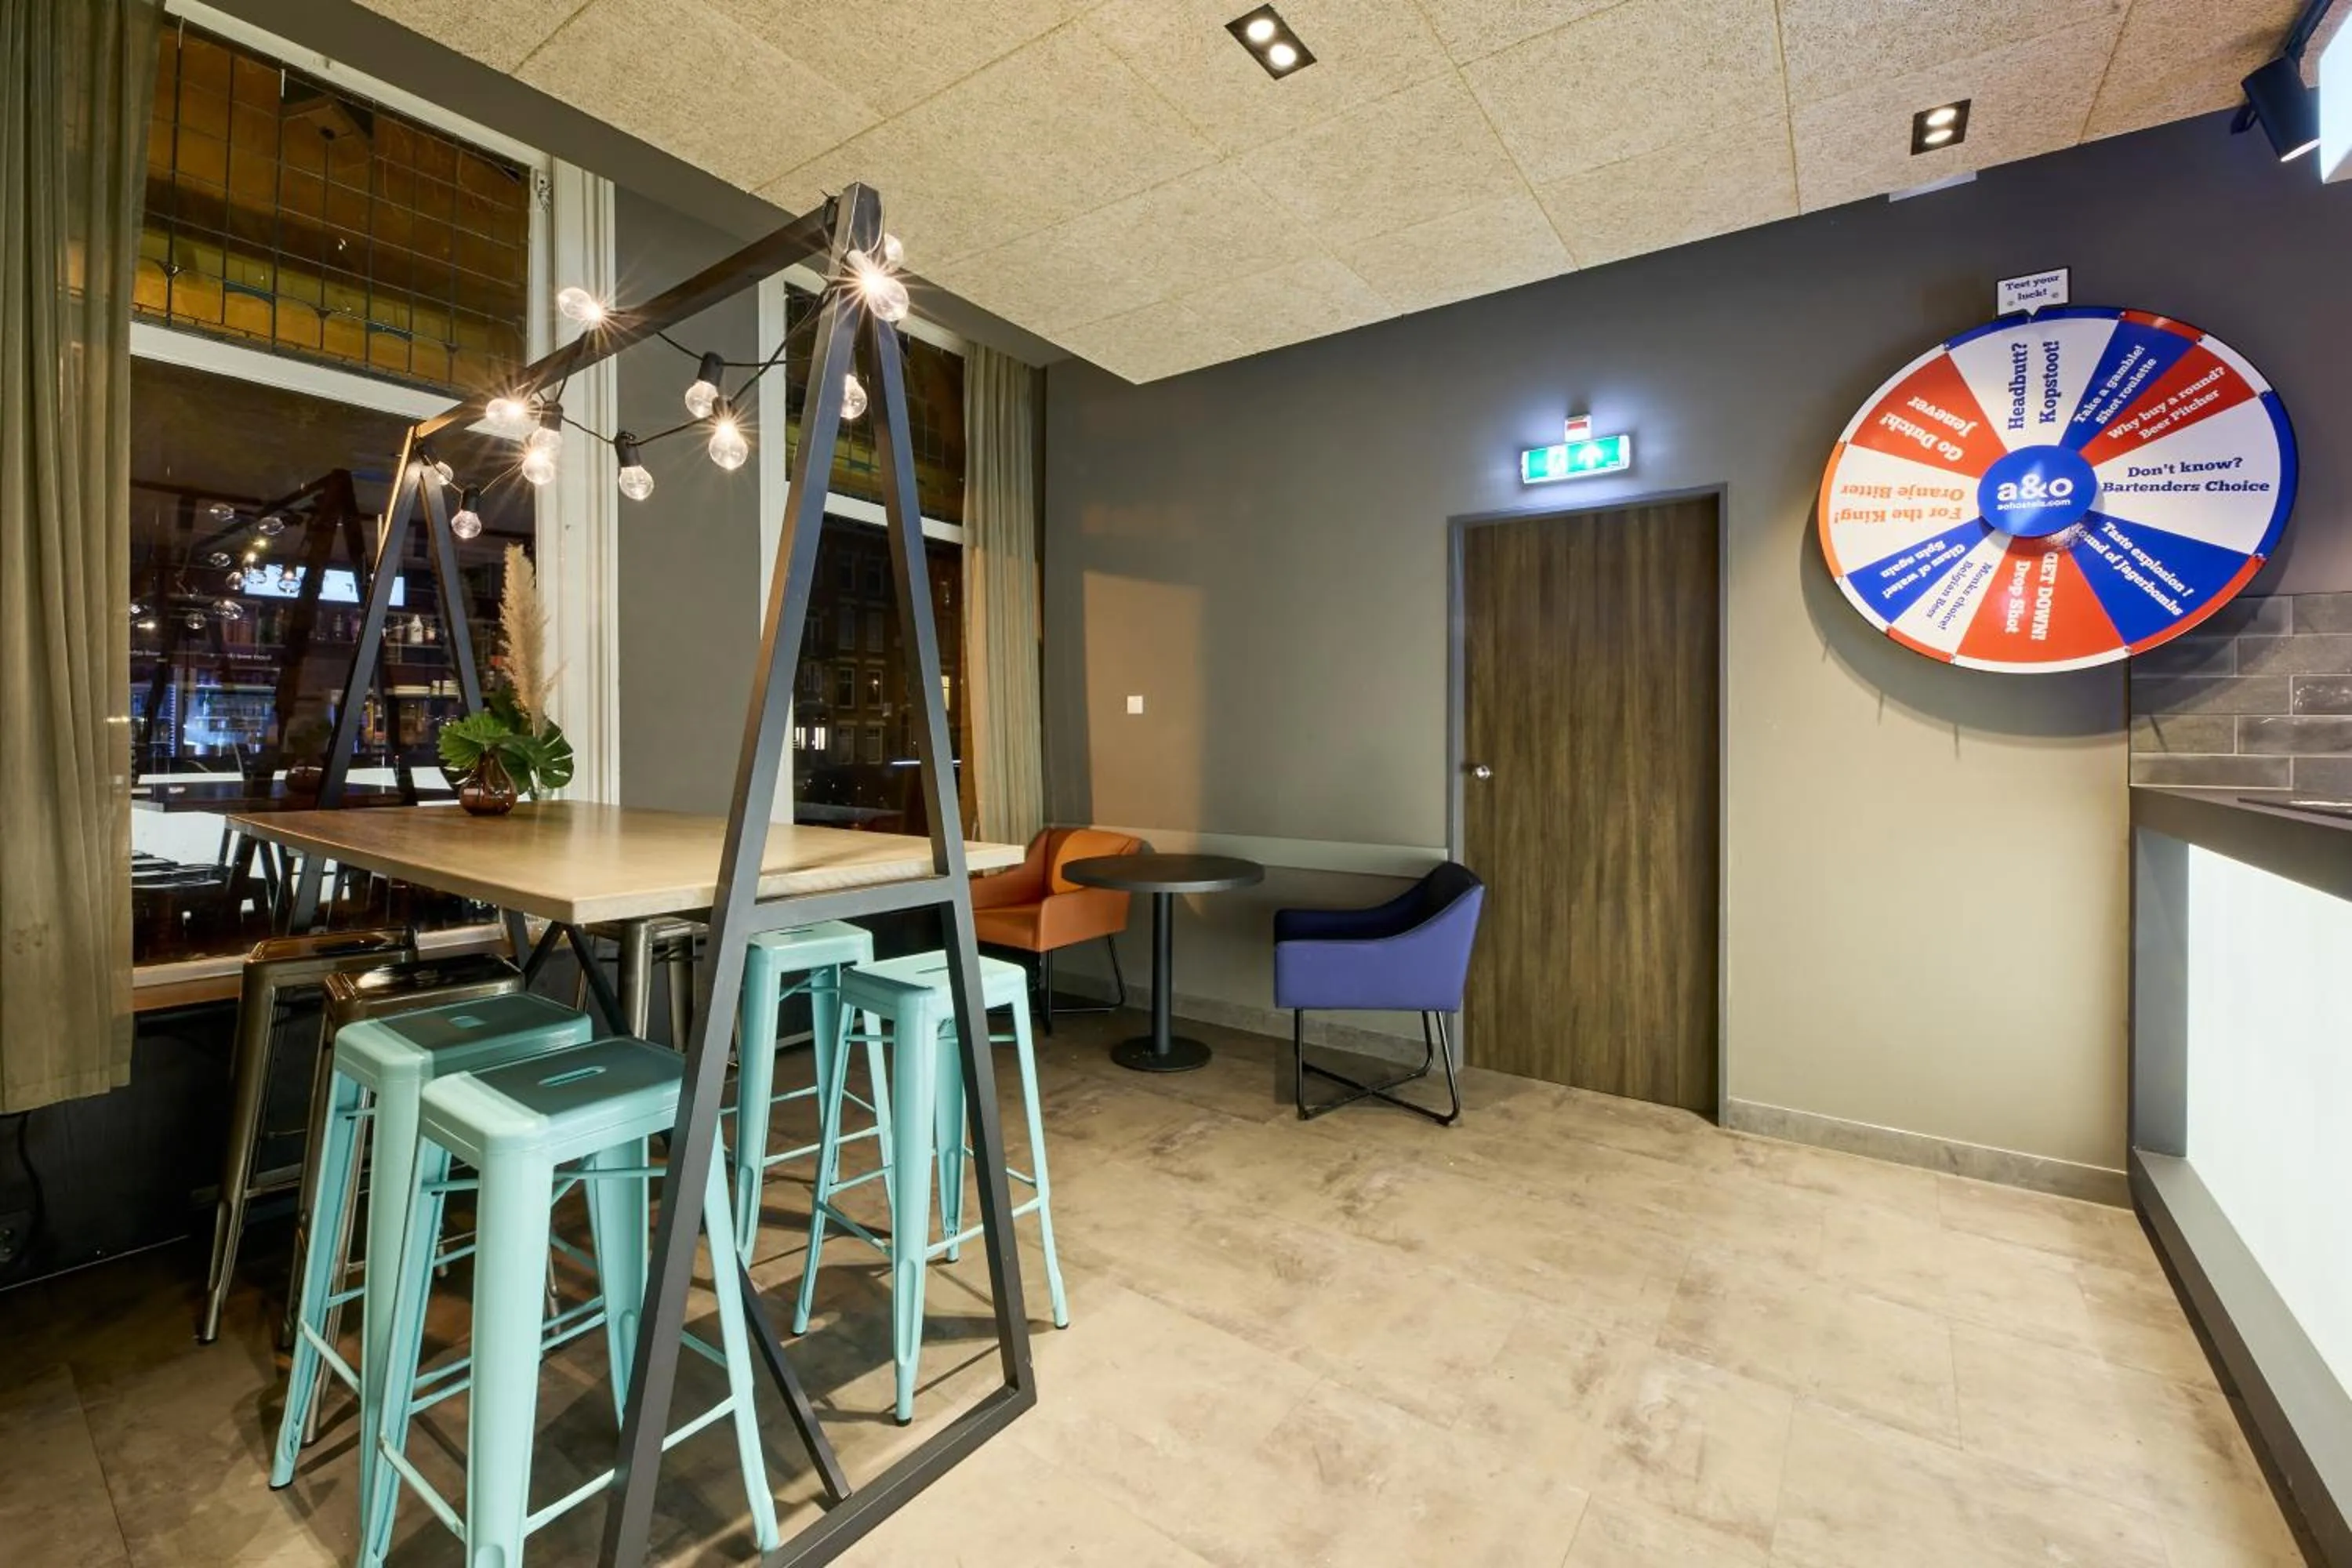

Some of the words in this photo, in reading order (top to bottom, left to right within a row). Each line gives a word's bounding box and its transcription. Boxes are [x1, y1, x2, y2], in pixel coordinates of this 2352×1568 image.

[2005, 281, 2030, 290] Test
[2033, 275, 2059, 287] your
[2017, 288, 2047, 300] luck!
[2008, 343, 2027, 430] Headbutt?
[2038, 340, 2062, 423] Kopstoot!
[2073, 396, 2101, 423] Take
[2099, 387, 2109, 397] a
[2107, 345, 2146, 389] gamble!
[2096, 398, 2123, 424] Shot
[2118, 358, 2157, 401] roulette
[2107, 417, 2140, 439] Why
[2139, 401, 2167, 421] buy
[2167, 397, 2179, 406] a
[2179, 365, 2227, 398] round?
[2139, 418, 2171, 439] Beer
[2169, 389, 2220, 421] Pitcher
[1879, 412, 1939, 450] Dutch!
[1907, 396, 1979, 438] Jenever
[1937, 440, 1964, 462] Go
[2128, 463, 2175, 477] Don't
[2180, 456, 2243, 473] know?
[1840, 484, 1893, 499] Bitter
[1897, 484, 1965, 501] Oranje
[1997, 473, 2074, 501] a&o
[2102, 480, 2200, 492] Bartenders
[2205, 479, 2270, 492] Choice
[1834, 508, 1886, 524] King!
[1892, 508, 1923, 521] the
[1929, 506, 1962, 520] For
[1915, 540, 1946, 559] Spin
[2101, 521, 2133, 550] Taste
[1880, 556, 1915, 578] again
[1931, 544, 1965, 567] Glass
[2040, 552, 2058, 584] GET
[1918, 564, 1932, 577] of
[1942, 561, 1973, 597] Belgian
[1963, 561, 1993, 596] Monks
[2009, 561, 2031, 597] Drop
[2104, 551, 2123, 564] of
[2114, 560, 2183, 615] Jagerbombs
[1926, 598, 1946, 619] Beer
[2005, 598, 2025, 633] Shot
[2031, 586, 2053, 640] DOWN!
